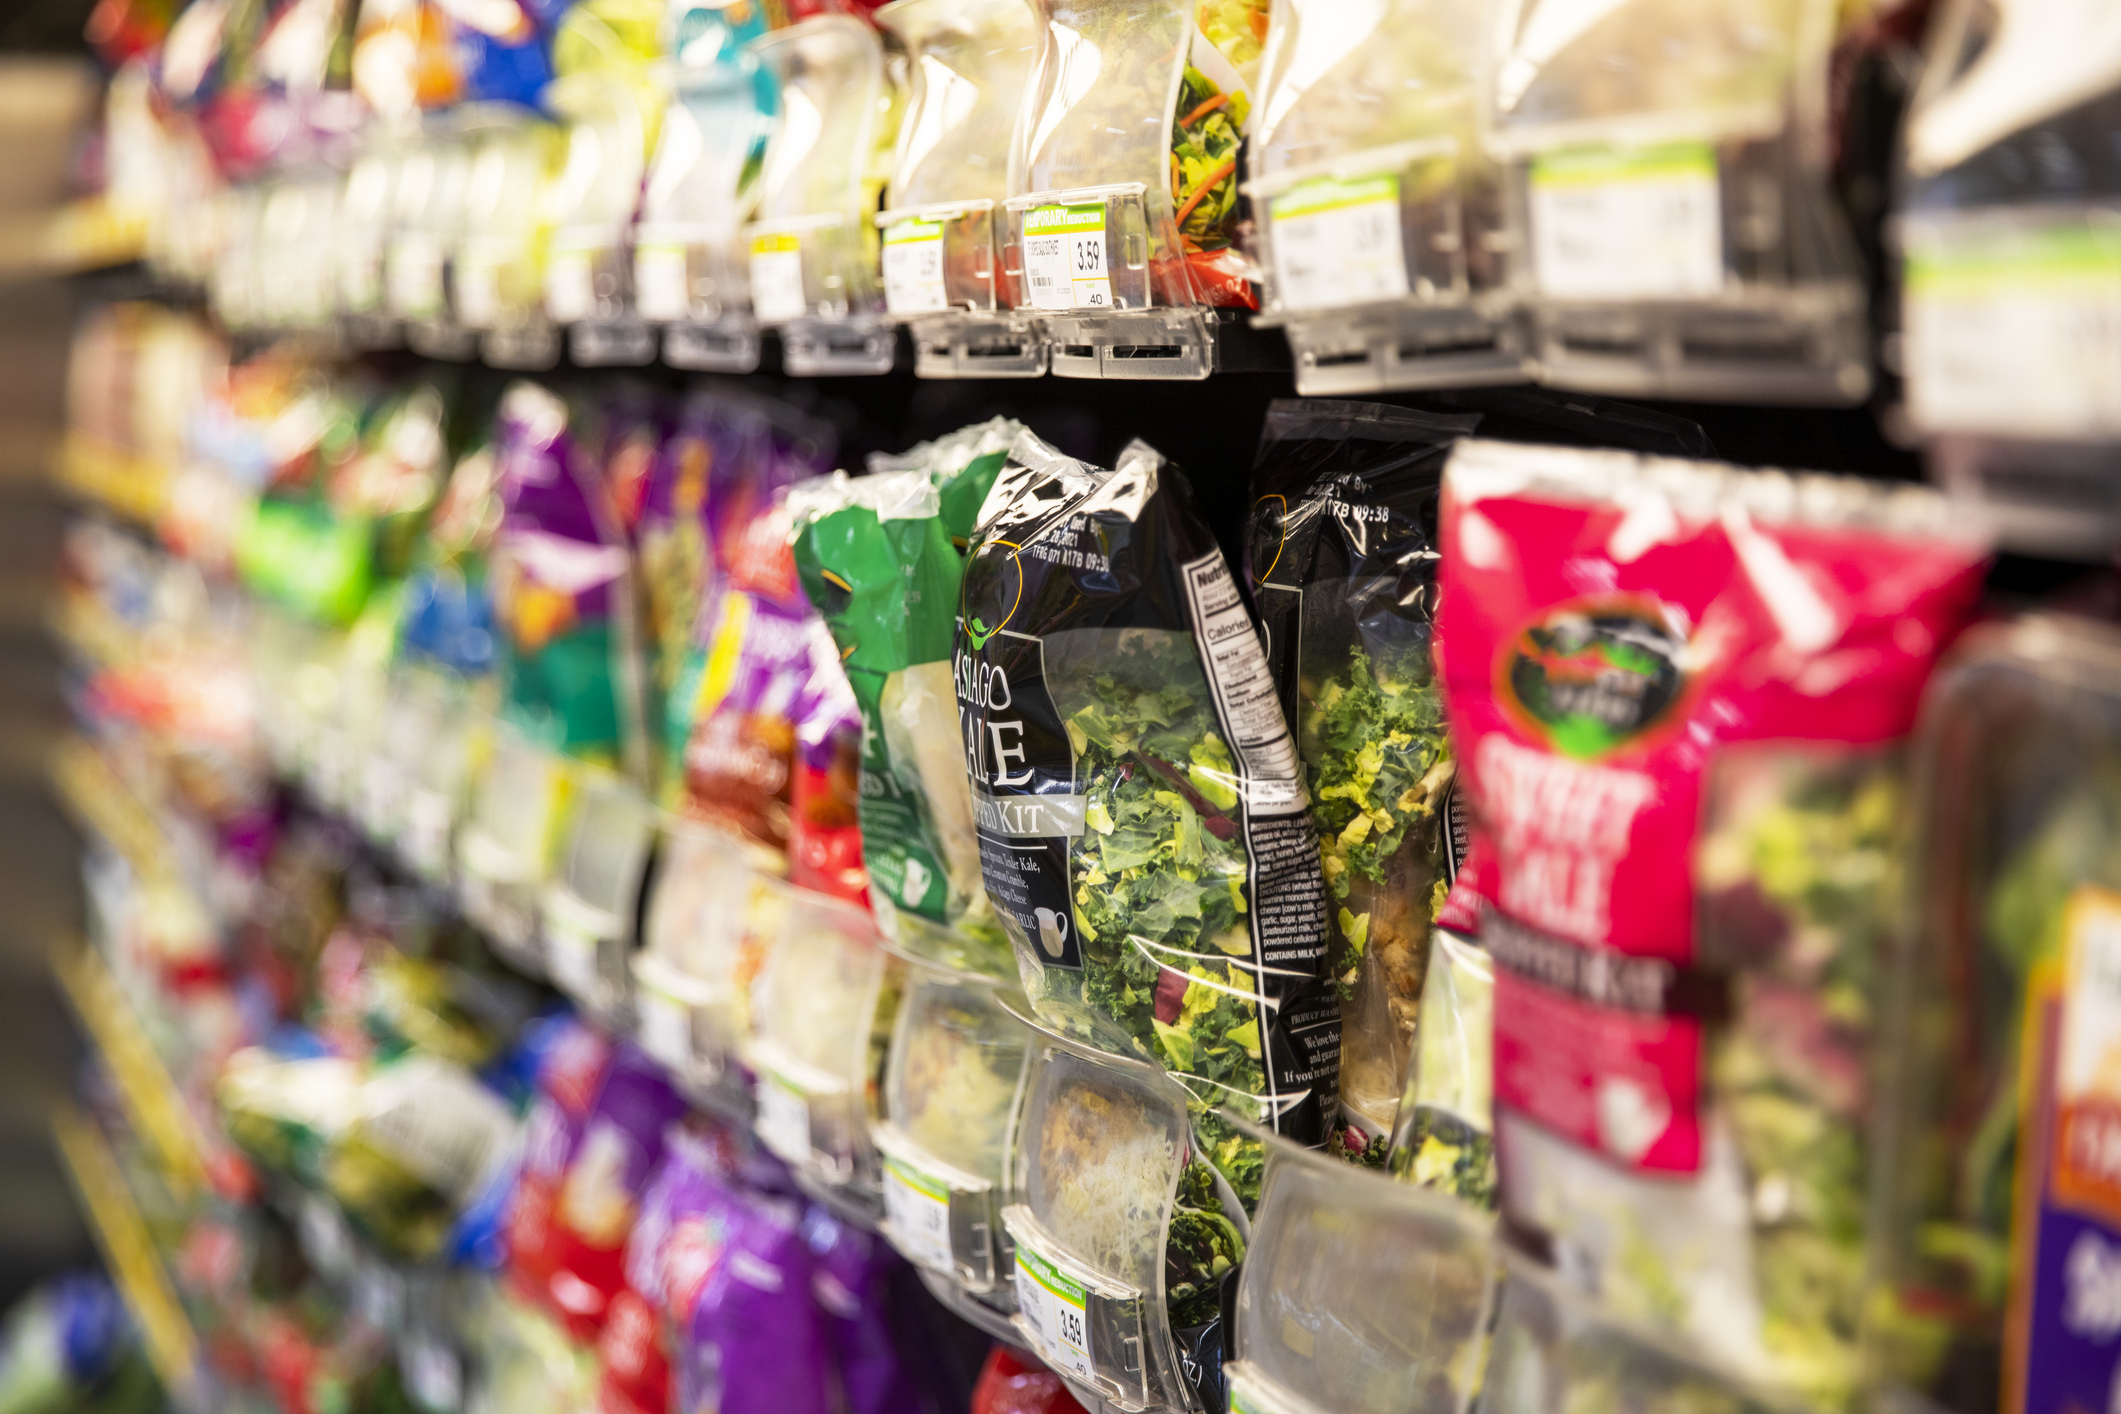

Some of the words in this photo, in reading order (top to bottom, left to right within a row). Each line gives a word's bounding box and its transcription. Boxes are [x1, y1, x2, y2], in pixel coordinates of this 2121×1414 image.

[1026, 208, 1068, 228] TEMPORARY
[1067, 212, 1100, 224] REDUCTION
[1078, 240, 1100, 270] 3.59
[1088, 294, 1102, 305] .40
[1352, 504, 1389, 522] 09:38
[1032, 545, 1048, 560] TFRG
[1048, 549, 1061, 564] 071
[1062, 550, 1084, 568] A17B
[954, 648, 1012, 710] ASIAGO
[959, 706, 1034, 786] ALE
[994, 800, 1044, 834] KIT
[1019, 856, 1040, 873] Kale,
[1260, 904, 1281, 915] cheese
[1264, 935, 1292, 948] powdered
[1265, 950, 1297, 961] CONTAINS
[1298, 948, 1316, 959] MILK,
[1304, 1037, 1316, 1049] We
[1316, 1034, 1329, 1048] love
[1328, 1030, 1340, 1043] the
[1309, 1050, 1322, 1064] and
[1284, 1070, 1294, 1082] If
[1296, 1066, 1320, 1084] you're
[1051, 1278, 1082, 1300] REDUCTION
[1061, 1309, 1082, 1346] 3.59
